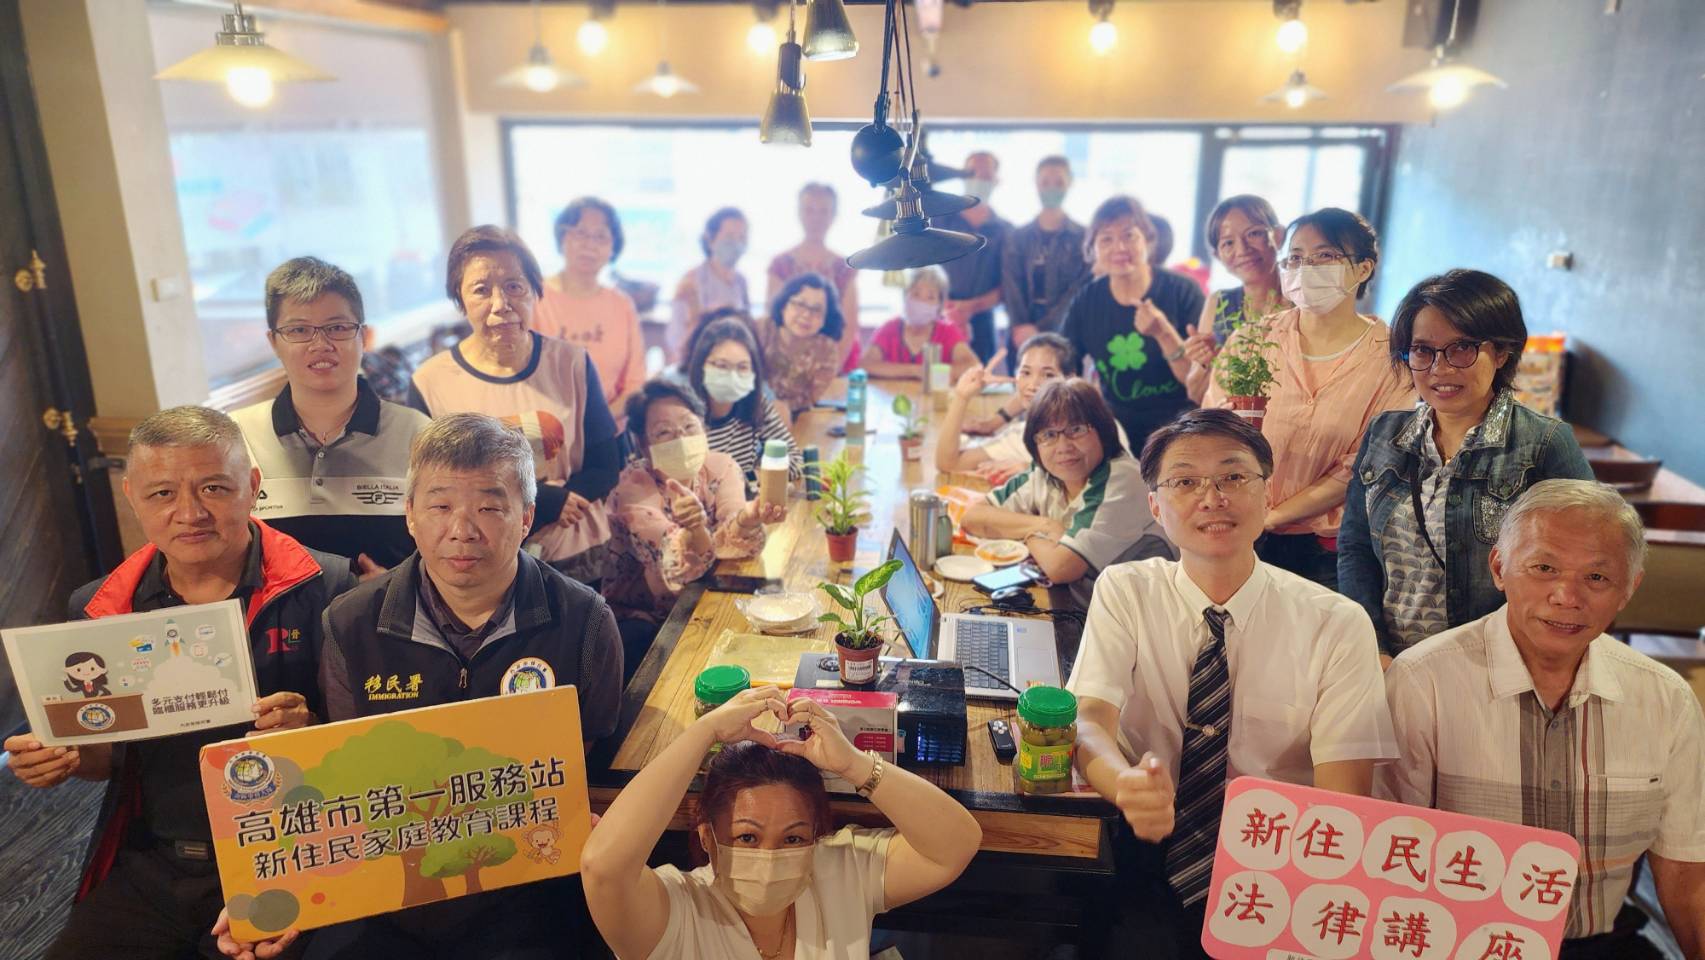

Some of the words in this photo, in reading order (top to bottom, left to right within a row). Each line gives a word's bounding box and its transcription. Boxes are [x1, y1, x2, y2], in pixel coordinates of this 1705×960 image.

[364, 673, 424, 694] 移民署
[368, 691, 419, 701] IMMIGRATION
[233, 756, 567, 848] 高雄市第一服務站
[253, 796, 560, 881] 新住民家庭教育課程
[1241, 808, 1572, 905] 新住民生活
[1224, 883, 1525, 960] 法律講座
